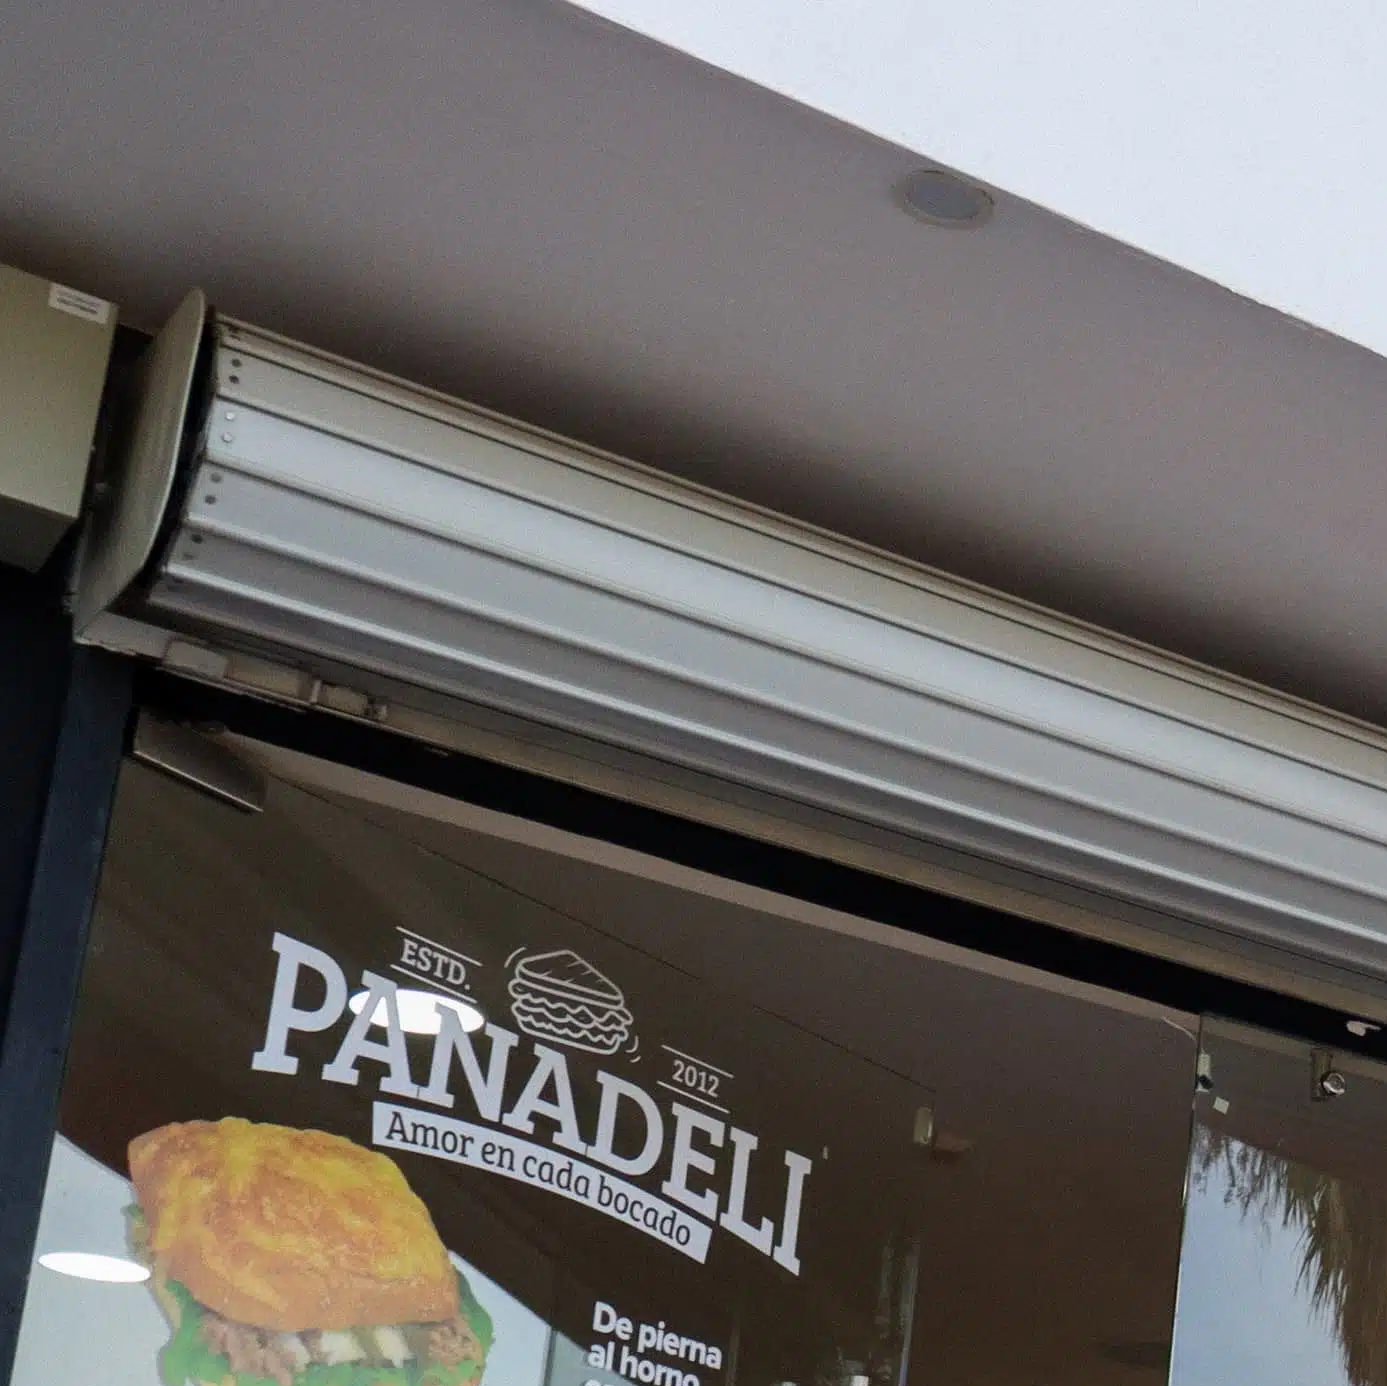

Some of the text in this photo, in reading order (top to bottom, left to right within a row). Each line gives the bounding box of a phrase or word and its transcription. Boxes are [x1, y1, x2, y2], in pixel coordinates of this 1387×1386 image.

[401, 939, 720, 1098] ESTD. 2012
[252, 932, 811, 1275] PANADELI
[385, 1111, 691, 1246] Amor en cada bocado
[587, 1340, 615, 1371] al
[592, 1301, 722, 1370] De pierna
